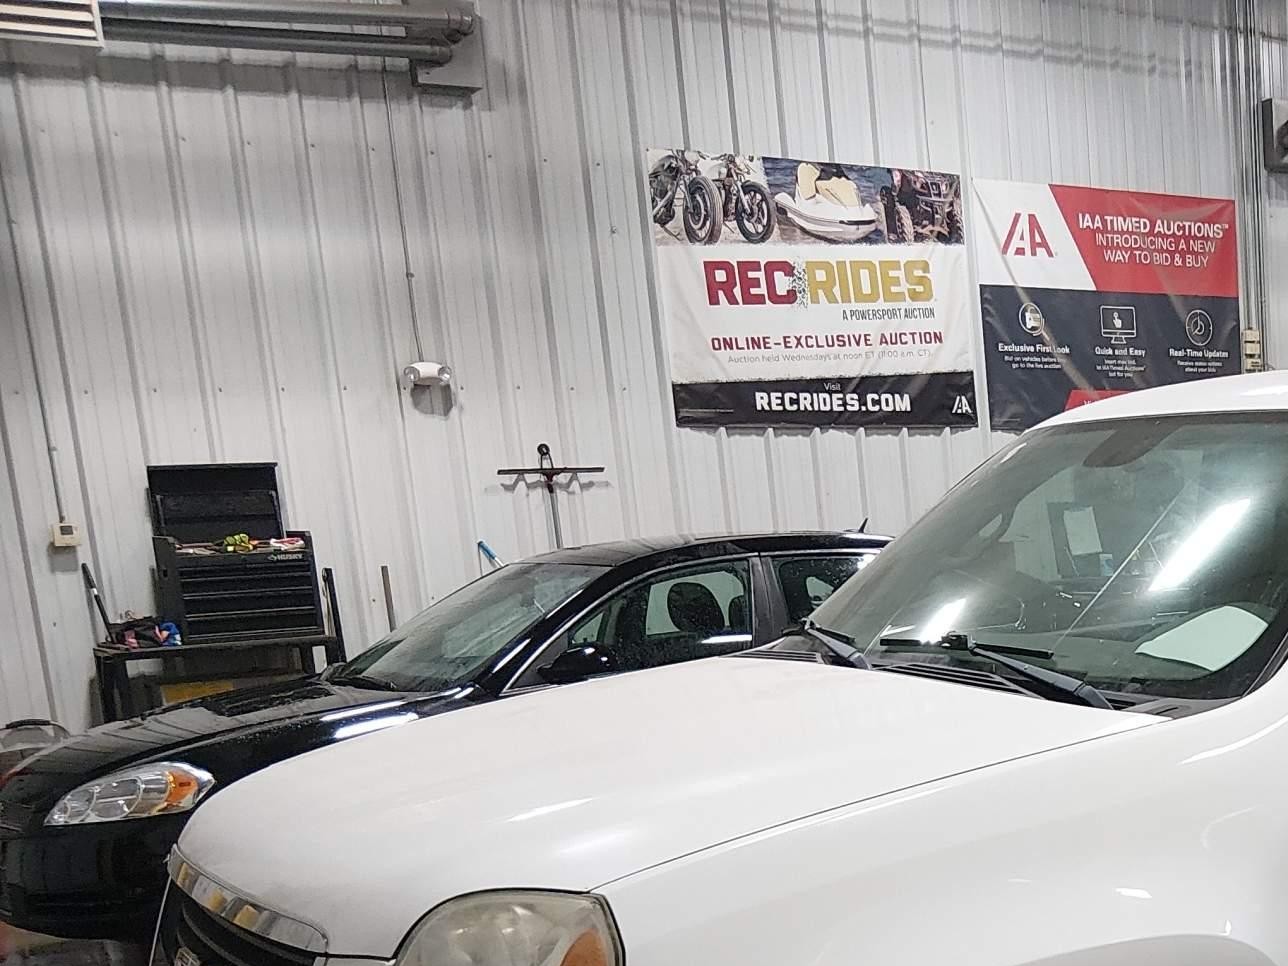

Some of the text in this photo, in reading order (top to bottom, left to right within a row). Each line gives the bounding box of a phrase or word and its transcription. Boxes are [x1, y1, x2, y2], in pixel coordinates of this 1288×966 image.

[1079, 213, 1103, 230] IAA
[1105, 216, 1150, 233] TIMED
[1096, 232, 1216, 253] INTRODUCING A NEW
[1104, 250, 1209, 268] WAY TO BID & BUY
[703, 260, 934, 306] REC RIDES
[843, 308, 935, 321] A POWERSPORT AUCTION
[712, 331, 943, 351] ONLINE-EXCLUSIVE AUCTION
[998, 343, 1034, 352] Exclusive
[1036, 344, 1052, 353] First
[728, 354, 760, 363] Auction
[762, 353, 780, 362] held
[843, 352, 862, 360] noon
[1095, 346, 1146, 357] Quick and Easy
[1169, 348, 1228, 358] Real-Time Updates
[823, 382, 841, 391] Visit
[755, 391, 911, 412] RECRIDES.COM
